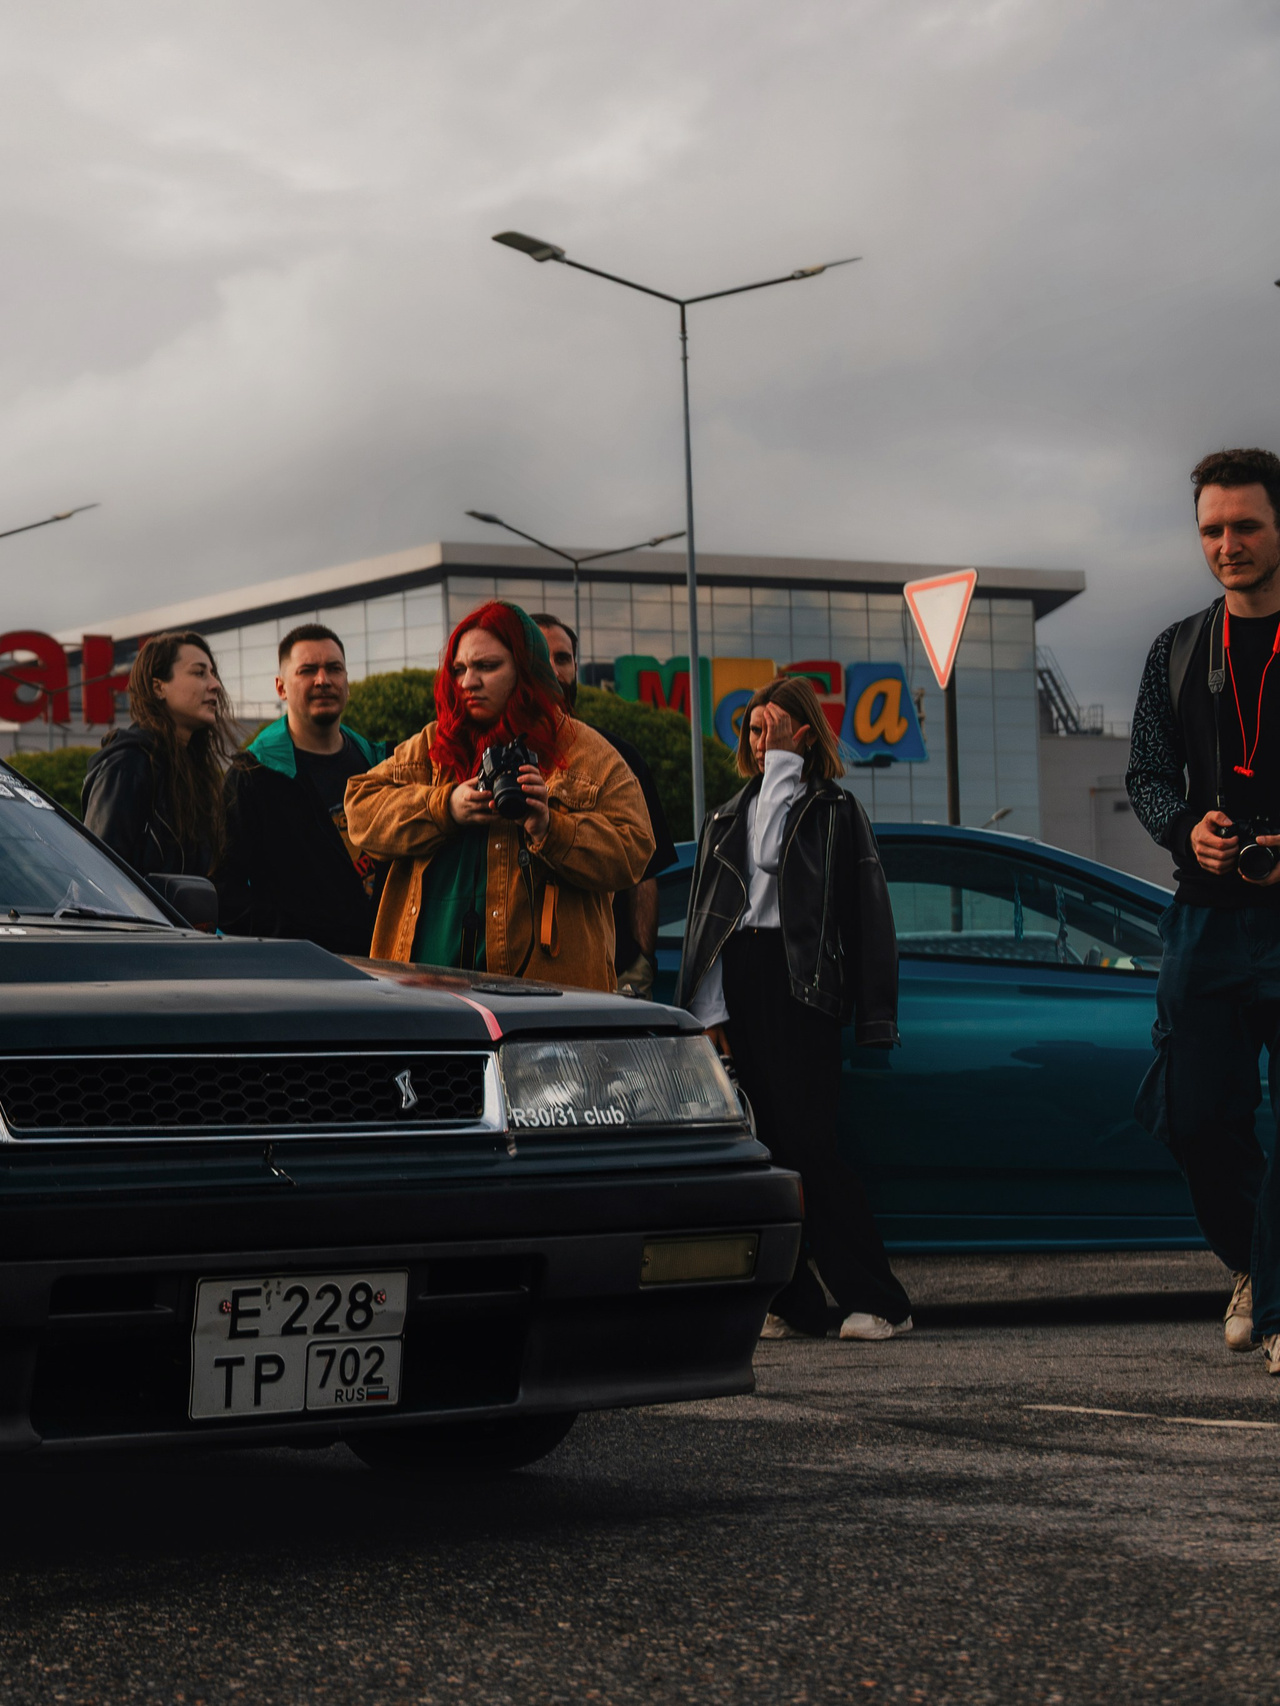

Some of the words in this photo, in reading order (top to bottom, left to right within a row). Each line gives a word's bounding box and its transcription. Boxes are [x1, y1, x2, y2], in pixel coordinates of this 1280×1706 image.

[512, 1106, 578, 1128] R30/31
[584, 1104, 625, 1126] club
[280, 1280, 374, 1337] 228
[315, 1345, 386, 1389] 702
[334, 1387, 366, 1404] RUS
